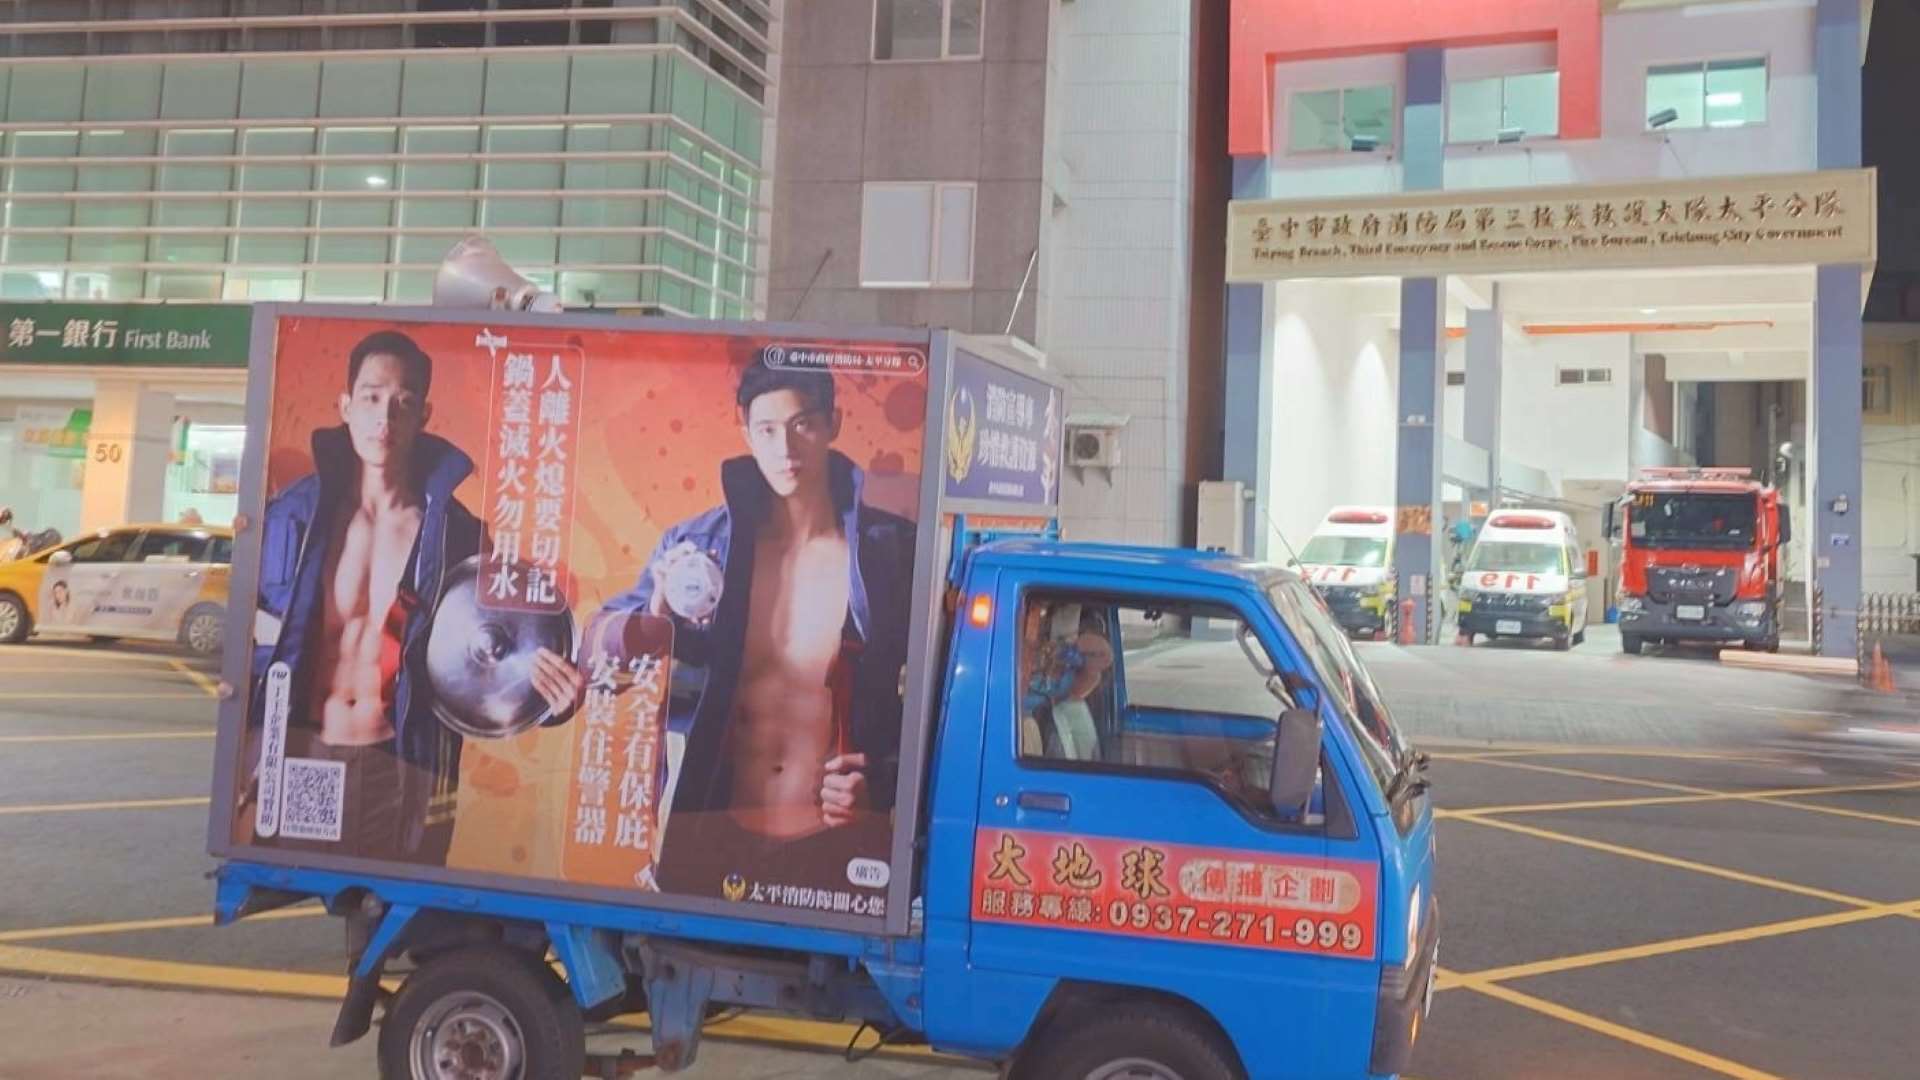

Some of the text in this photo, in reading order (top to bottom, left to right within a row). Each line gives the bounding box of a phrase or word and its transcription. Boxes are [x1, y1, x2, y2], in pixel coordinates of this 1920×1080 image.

[1756, 226, 1843, 241] Government
[8, 317, 119, 348] 第一銀行
[124, 329, 212, 349] First Bank
[94, 443, 123, 463] 50
[488, 353, 535, 600] 鍋蓋滅火勿用水
[525, 354, 572, 603] 人離火熄要切記
[574, 651, 620, 845] 安裝住警器
[614, 653, 662, 849] 安全有保庇
[855, 864, 881, 882] 廣告
[988, 834, 1170, 899] 大地球
[750, 881, 886, 917] 太平消防隊關心您
[982, 888, 1362, 950] 服務專線: 0937-271-999
